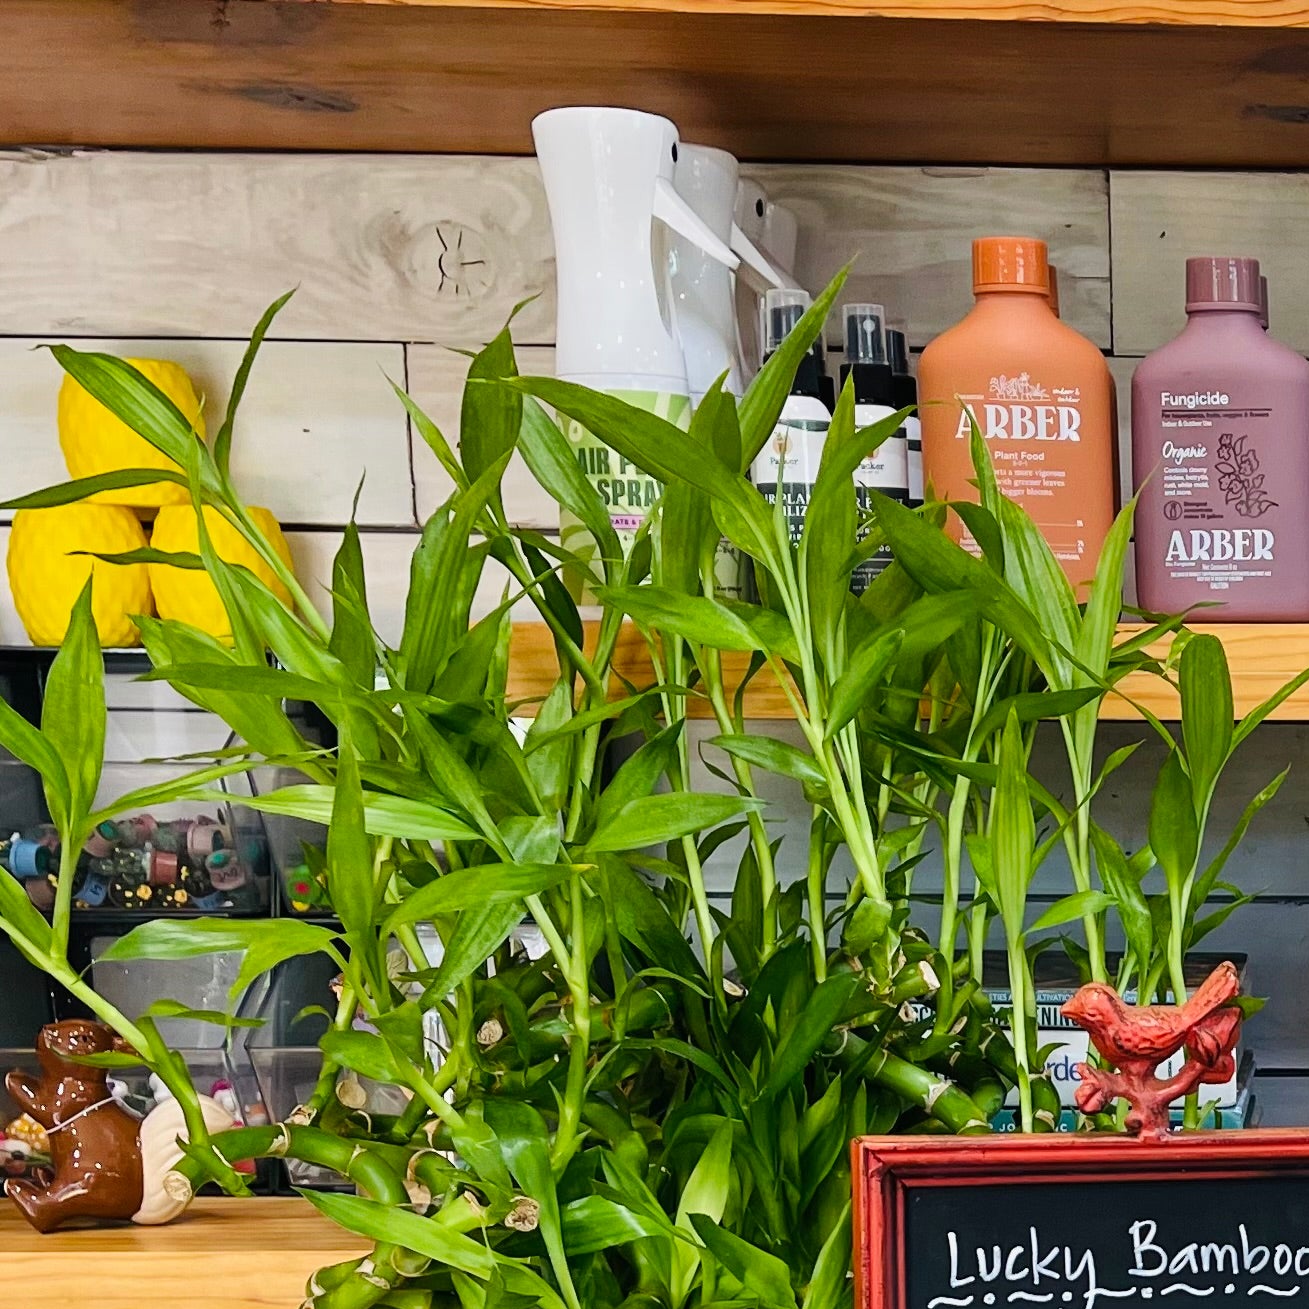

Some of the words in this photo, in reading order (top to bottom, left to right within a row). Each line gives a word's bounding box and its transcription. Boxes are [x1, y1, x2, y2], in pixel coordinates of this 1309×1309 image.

[1161, 391, 1229, 408] Fungicide
[955, 403, 1081, 442] ARBER
[578, 447, 610, 475] AIR
[994, 450, 1018, 460] Plant
[1020, 452, 1045, 461] Food
[1162, 440, 1208, 465] Organic
[859, 462, 884, 471] acker
[782, 493, 812, 506] PLA
[1165, 529, 1275, 561] ARBER
